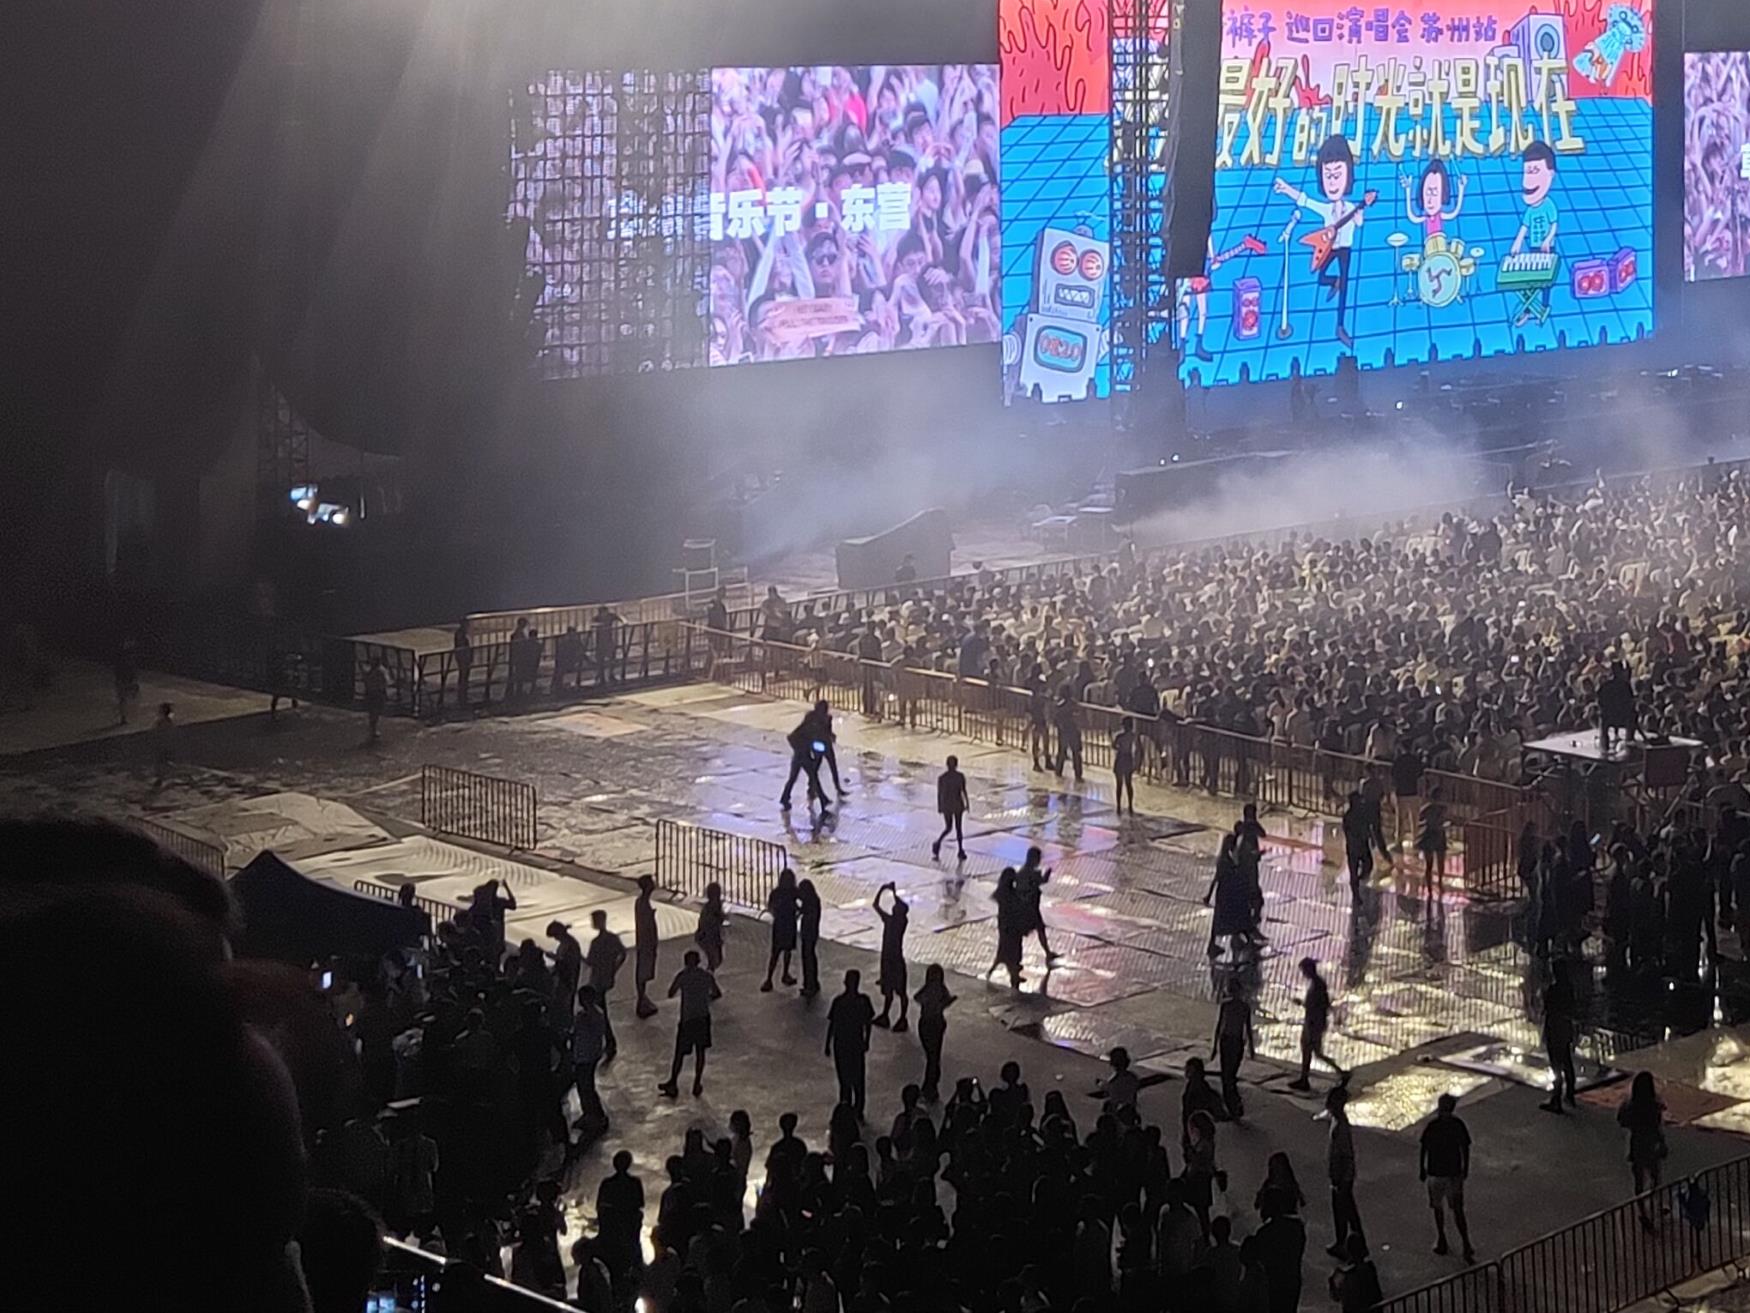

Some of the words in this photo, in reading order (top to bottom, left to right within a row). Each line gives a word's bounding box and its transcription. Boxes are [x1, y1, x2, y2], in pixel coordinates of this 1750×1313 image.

[1285, 7, 1412, 44] 巡回演唱会
[1419, 11, 1498, 44] 苏州站
[1215, 52, 1586, 169] 最好的时光就是现在
